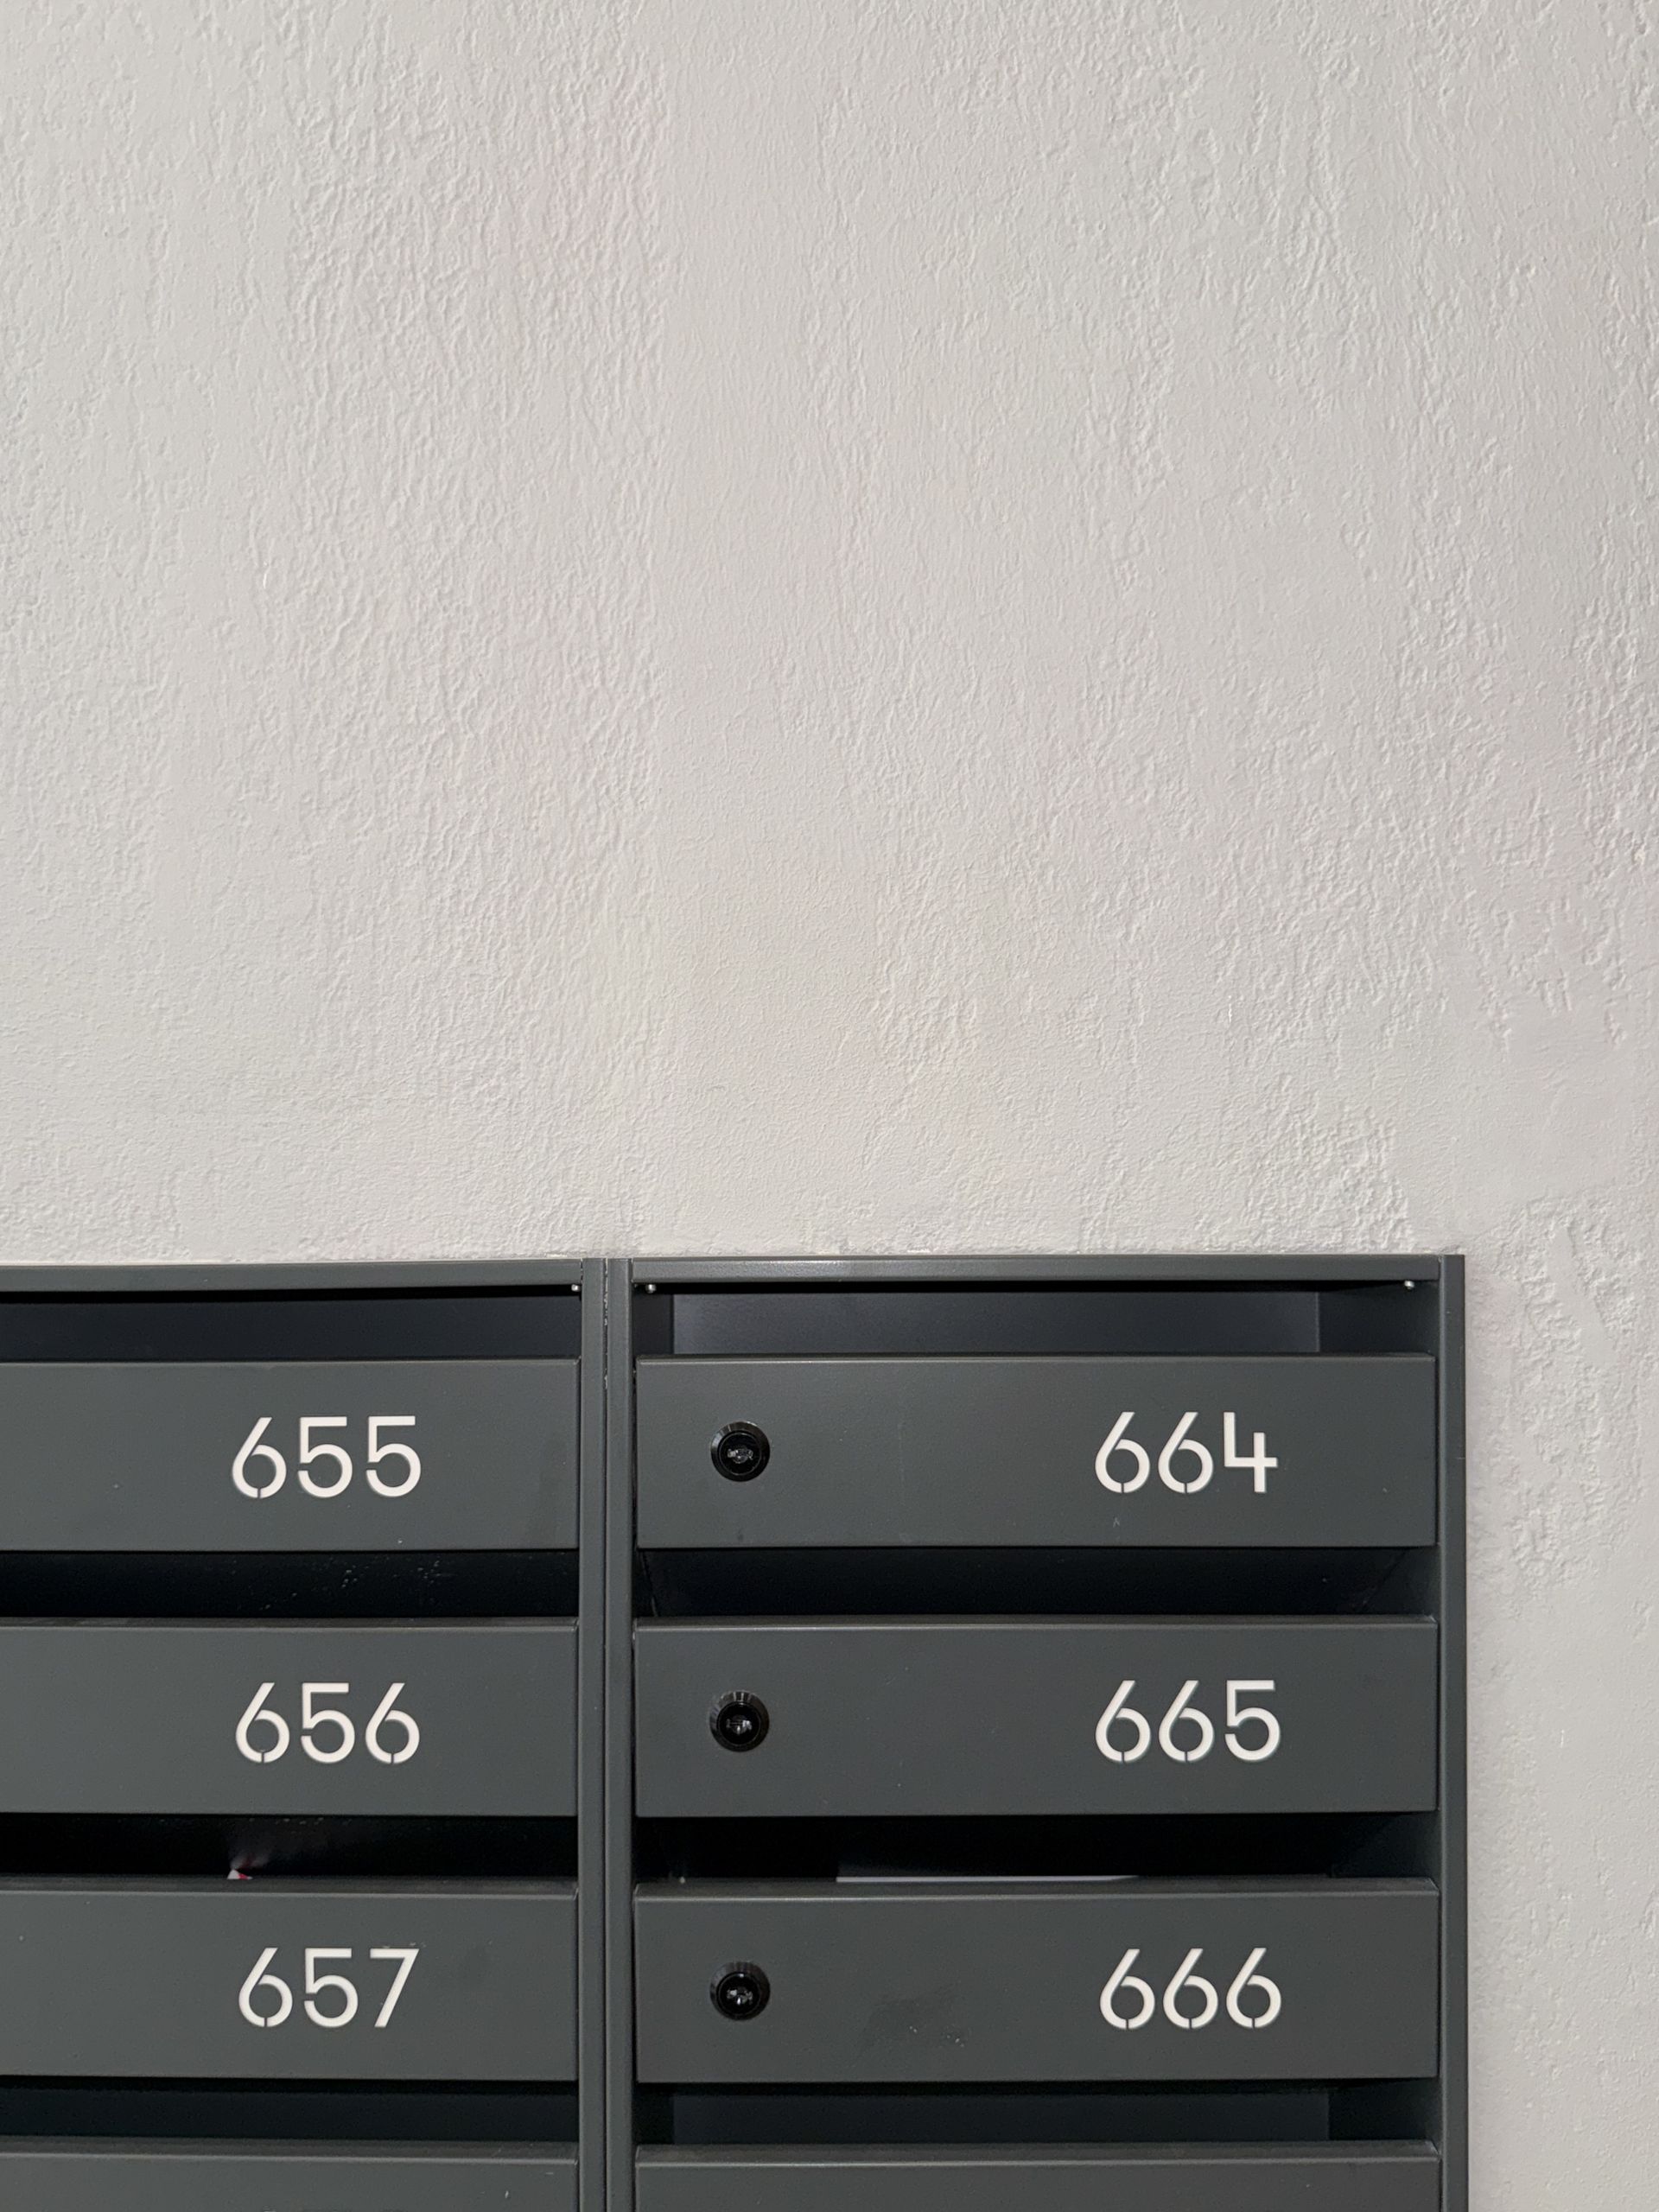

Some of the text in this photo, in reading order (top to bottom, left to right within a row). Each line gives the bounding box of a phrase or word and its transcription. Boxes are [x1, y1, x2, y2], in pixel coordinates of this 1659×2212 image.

[232, 1415, 422, 1499] 655
[1095, 1411, 1278, 1494] 664
[235, 1682, 420, 1764] 656
[1095, 1680, 1281, 1763] 665
[238, 1947, 420, 2028] 657
[1099, 1948, 1281, 2030] 666
